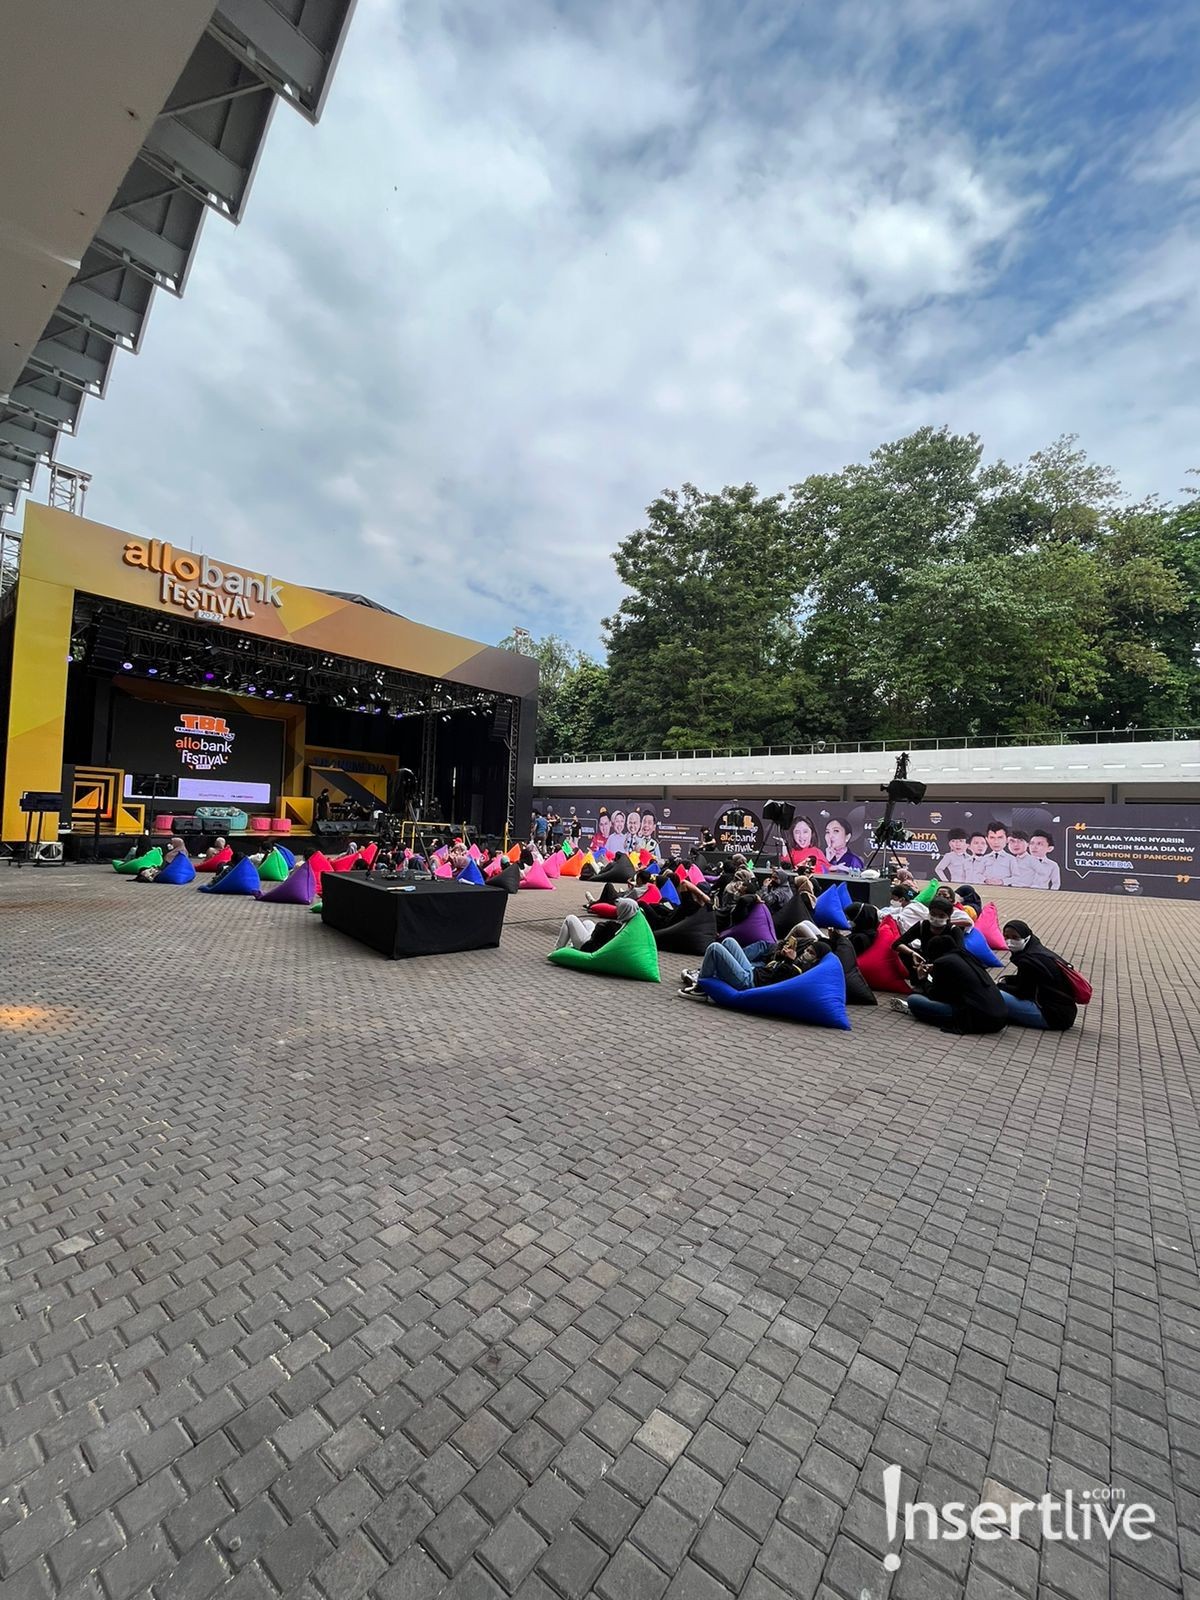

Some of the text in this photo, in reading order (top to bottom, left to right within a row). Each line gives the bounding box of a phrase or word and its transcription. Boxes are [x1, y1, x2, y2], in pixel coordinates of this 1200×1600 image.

[123, 538, 285, 607] allobank
[160, 573, 256, 620] FESTIVAL
[181, 714, 230, 734] TBL
[176, 737, 232, 753] allobank
[182, 750, 227, 765] FESTIVAL
[1075, 859, 1134, 869] TRANSMEDIA
[1144, 854, 1193, 862] PANGGUNG
